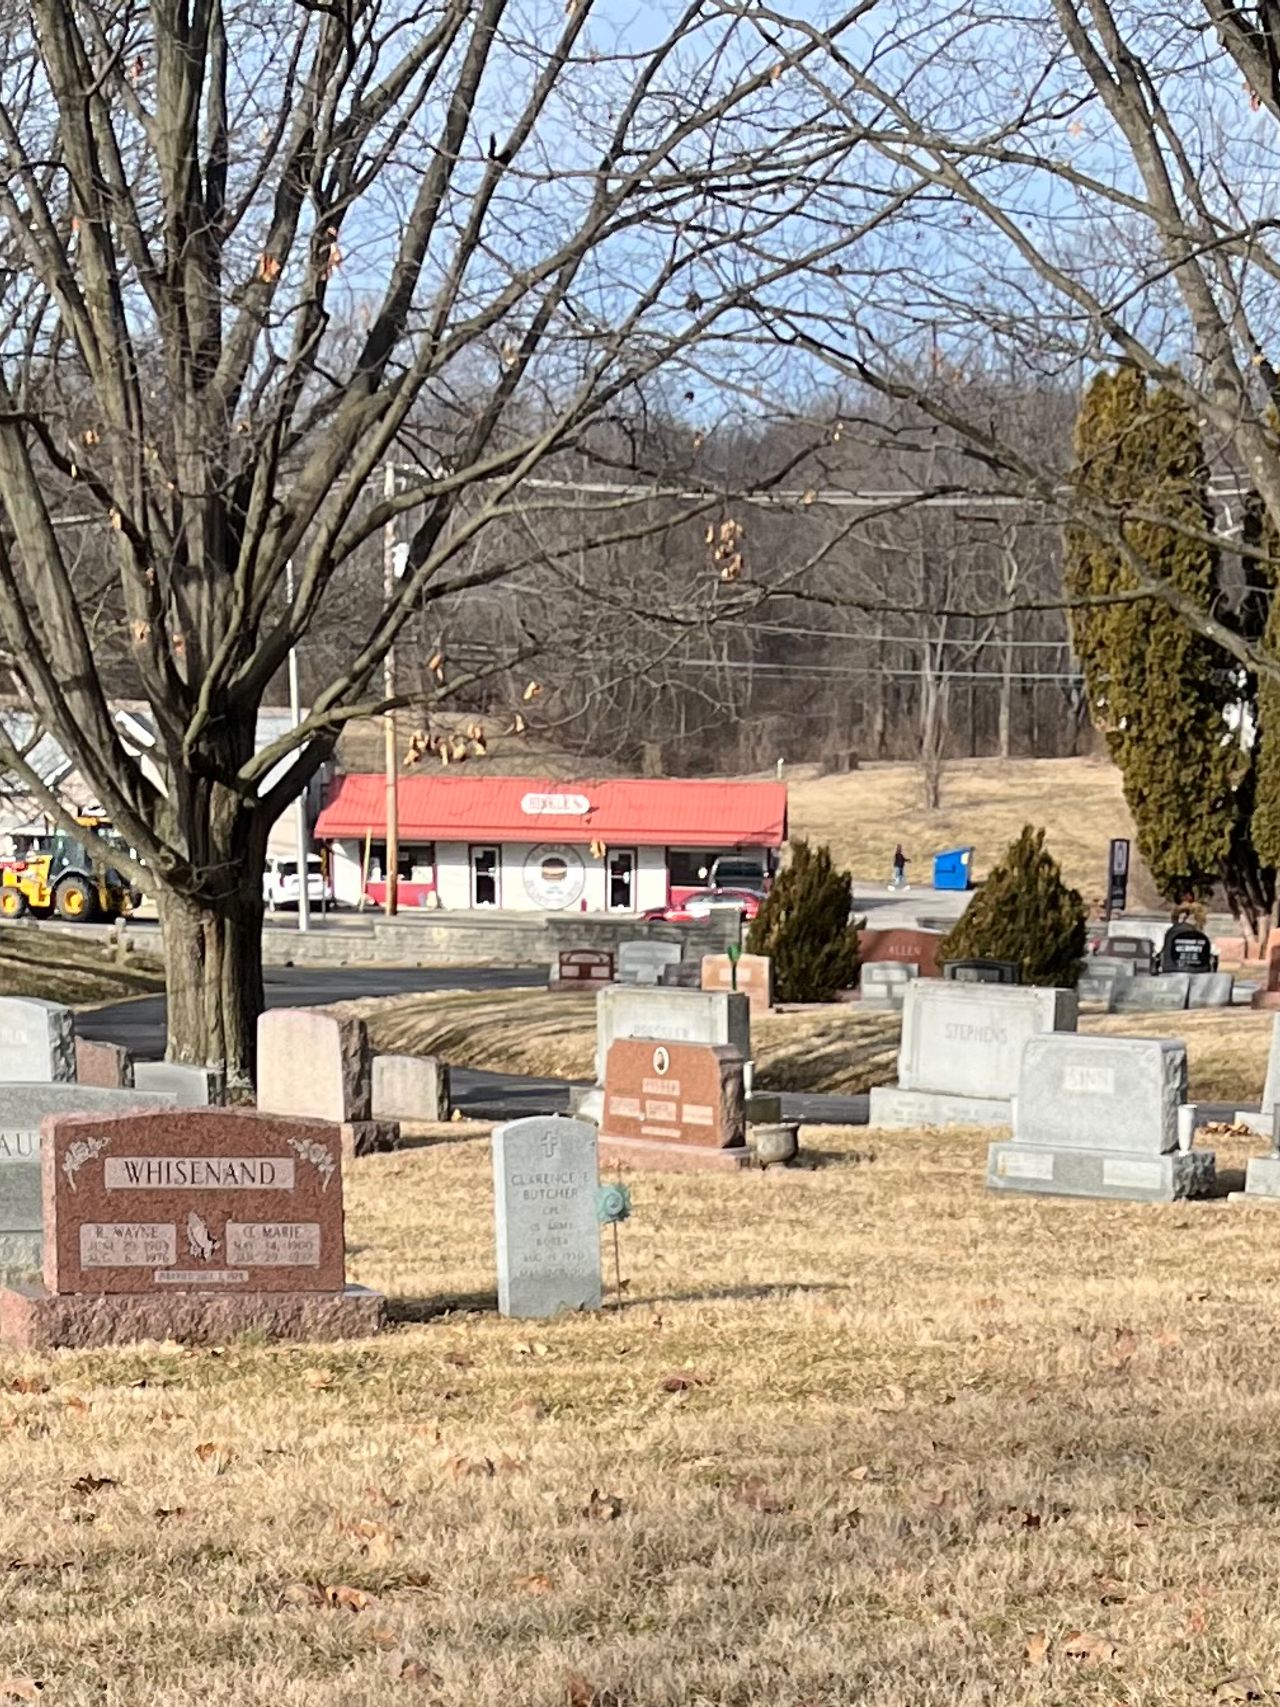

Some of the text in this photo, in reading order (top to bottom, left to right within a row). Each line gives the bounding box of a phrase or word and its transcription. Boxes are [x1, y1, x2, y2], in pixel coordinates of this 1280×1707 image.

[945, 1023, 1008, 1046] STEPHENS
[124, 1158, 277, 1186] WHISENAND
[511, 1172, 574, 1187] CLARENCE
[523, 1186, 579, 1200] BUTCHER
[262, 1226, 302, 1239] MARIE
